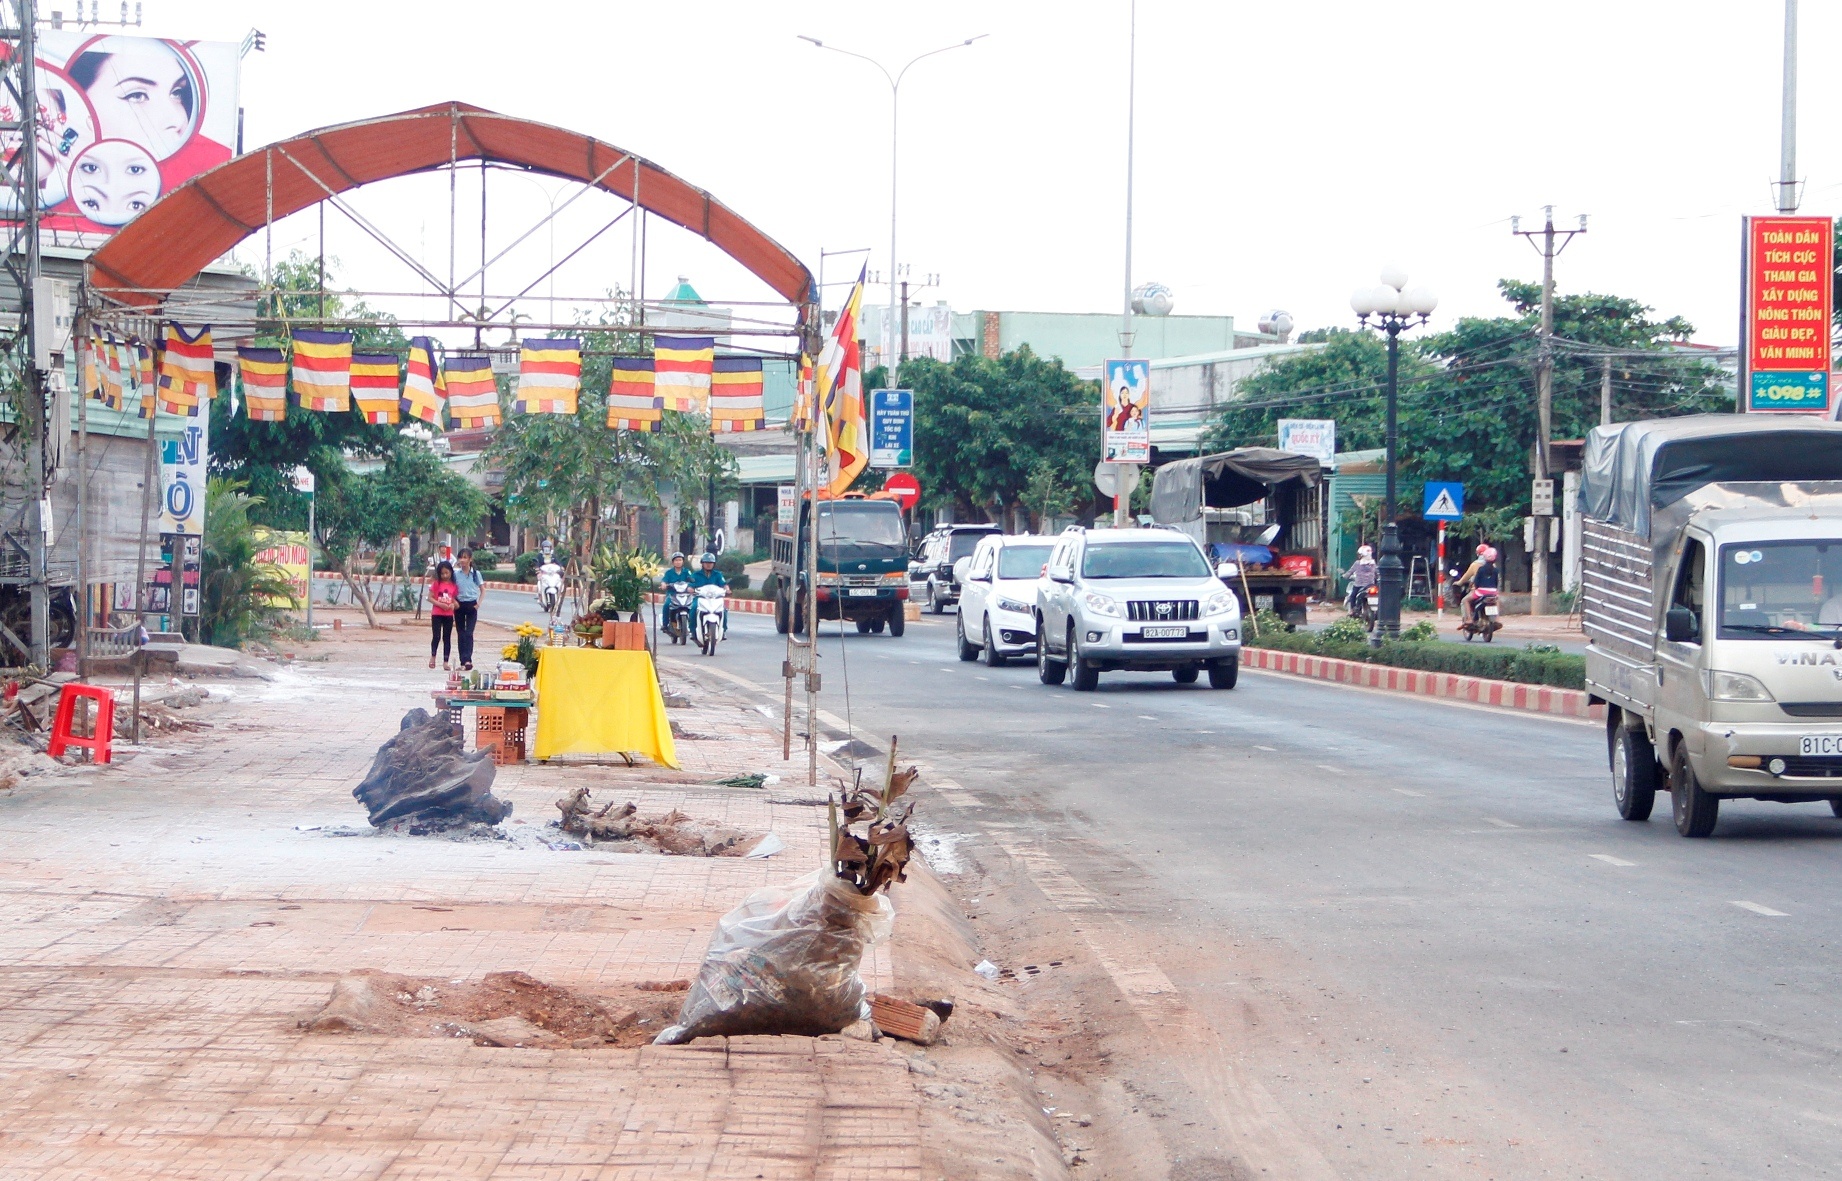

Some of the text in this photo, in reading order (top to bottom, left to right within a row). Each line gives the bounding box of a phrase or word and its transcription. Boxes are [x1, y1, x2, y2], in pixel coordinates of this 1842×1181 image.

[1762, 229, 1819, 244] TOÀN DÂN
[1764, 248, 1817, 266] TÍCH CỰC
[1763, 270, 1817, 282] THAM GIA
[1762, 286, 1819, 303] XÂY DỰNG
[1758, 306, 1822, 320] NÔNG THÔN
[1761, 325, 1817, 342] GIÀU ĐẸP,
[1760, 345, 1783, 358] VĂN
[1785, 347, 1814, 359] MINH
